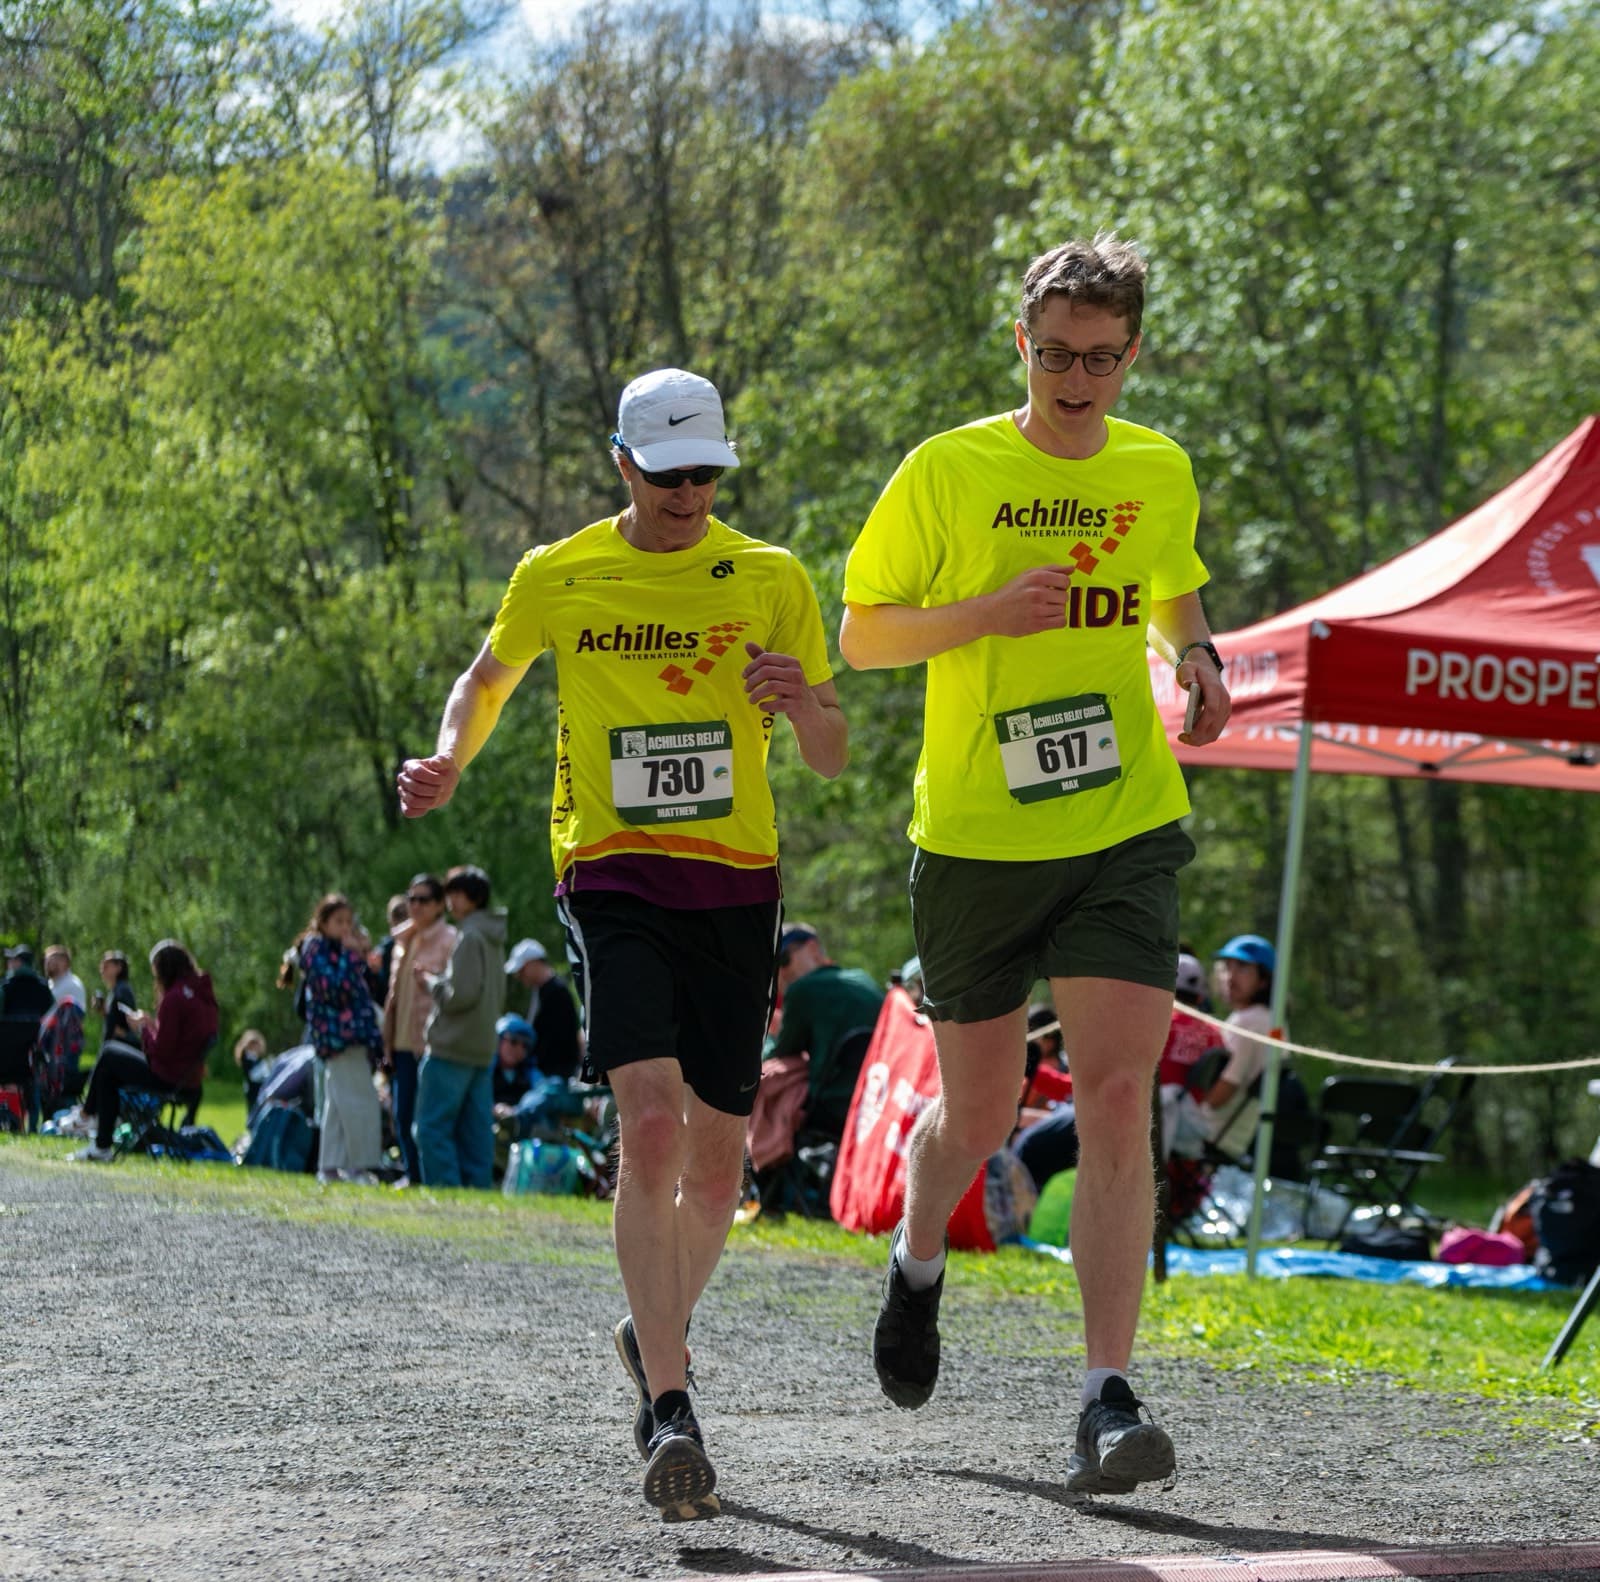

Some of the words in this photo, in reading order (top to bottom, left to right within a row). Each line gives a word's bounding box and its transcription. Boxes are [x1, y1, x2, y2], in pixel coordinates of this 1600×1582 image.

[992, 499, 1108, 528] Achilles
[1020, 529, 1104, 538] INTERNATIONAL
[1068, 584, 1140, 628] IDE
[576, 624, 700, 653] Achilles
[620, 651, 698, 660] INTERNATIONAL
[1405, 648, 1600, 710] PROSPE
[1033, 713, 1064, 729] ACHILLES
[1063, 708, 1083, 724] RELAY
[1083, 704, 1106, 719] GUIDES
[647, 734, 696, 751] ACHILLES
[696, 731, 726, 747] RELAY
[1036, 731, 1088, 774] 617
[642, 757, 705, 798] 730
[1061, 779, 1080, 791] MAX
[656, 806, 698, 818] MATTHEW
